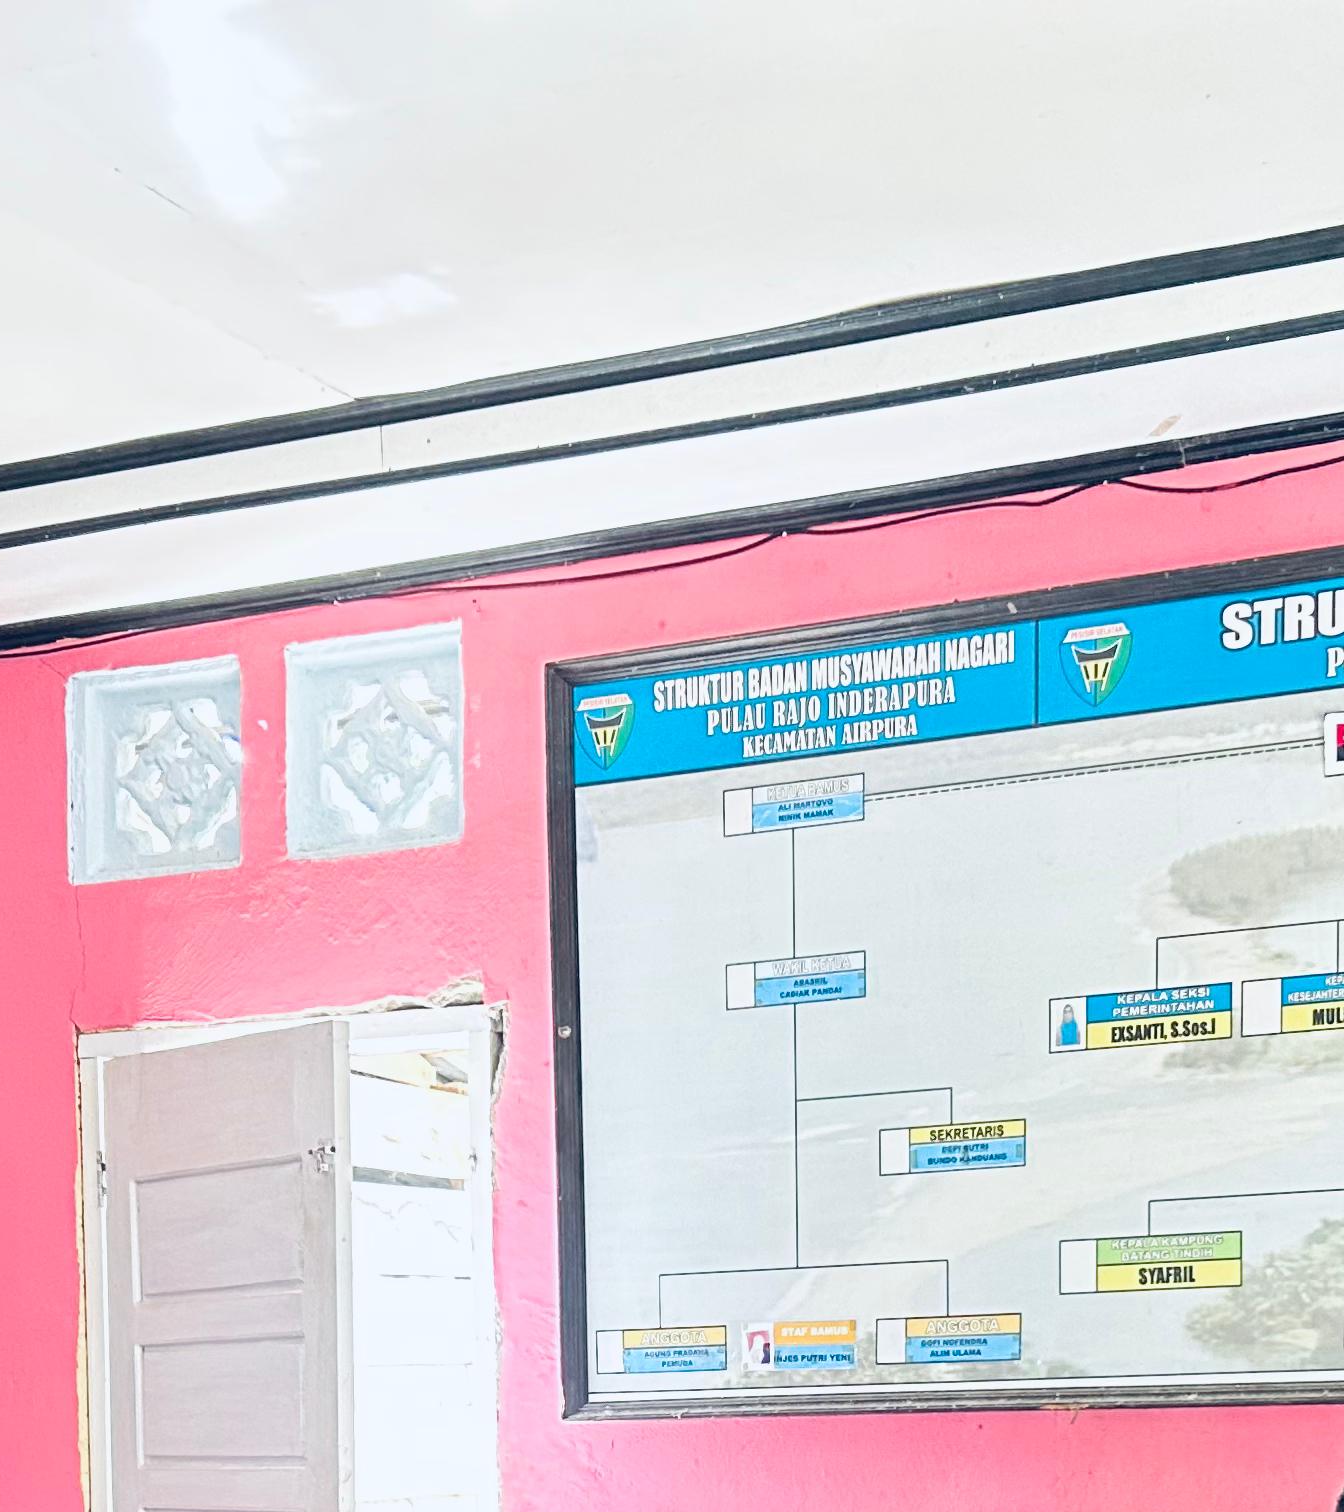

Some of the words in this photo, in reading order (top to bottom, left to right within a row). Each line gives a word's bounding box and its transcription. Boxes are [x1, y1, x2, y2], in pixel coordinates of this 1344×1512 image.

[654, 671, 744, 712] STRUKTUR
[748, 660, 807, 698] BADAN
[812, 642, 941, 691] MUSYAWARAH
[945, 630, 1015, 672] NAGARI
[707, 701, 766, 736] PULAU
[773, 697, 820, 729] RAJO
[827, 676, 956, 719] INDERAPURA
[742, 726, 836, 758] KECAMATAN
[841, 714, 918, 745] AIRPURA
[807, 778, 849, 797] BAMUS
[1118, 992, 1168, 1004] KEPALA
[1172, 987, 1210, 999] SEKSI
[1112, 1000, 1214, 1017] PEMERINTAHAN
[930, 1125, 1004, 1141] SEKRETARIS
[1111, 1240, 1160, 1250] KEPALA
[1162, 1235, 1224, 1246] KAMPUNG
[1138, 1265, 1196, 1285] SYAFRIL
[925, 1318, 1001, 1335] ANGGOTA
[640, 1331, 708, 1345] ANGGOTA
